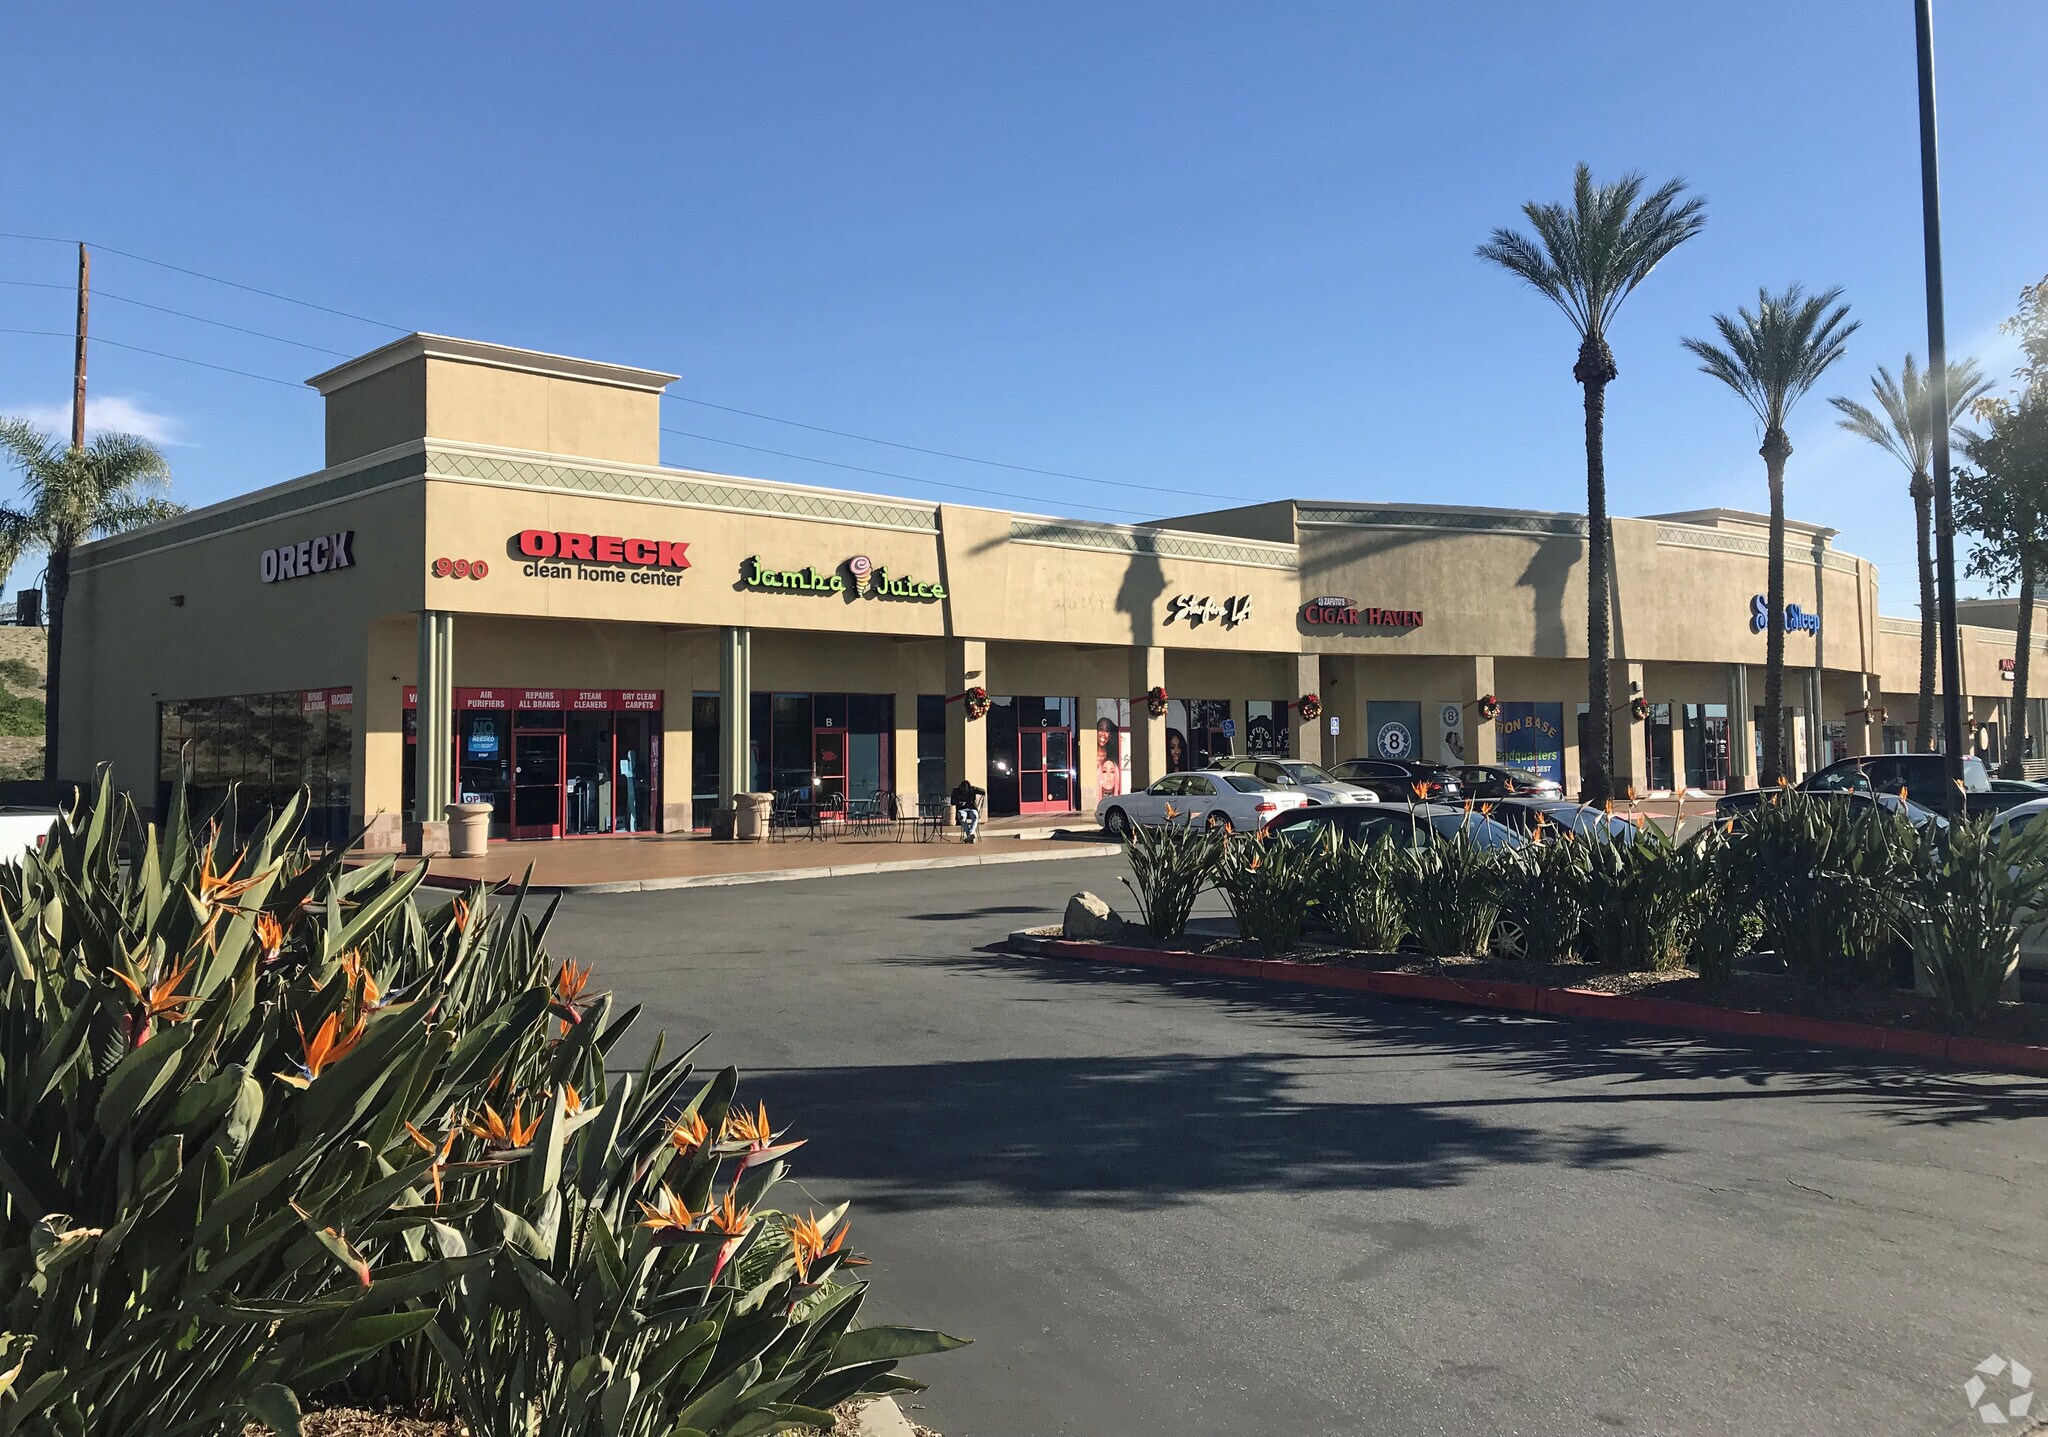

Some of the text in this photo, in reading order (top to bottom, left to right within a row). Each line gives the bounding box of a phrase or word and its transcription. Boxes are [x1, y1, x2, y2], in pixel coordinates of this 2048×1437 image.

[519, 529, 692, 568] ORECK
[260, 531, 353, 583] ORECK
[435, 557, 489, 580] 990
[747, 554, 846, 592] jamba
[523, 562, 683, 587] clean home center
[1231, 594, 1254, 626] LA
[1305, 605, 1424, 627] CIGAR HAVEN
[1791, 603, 1820, 635] Sleep
[479, 691, 493, 699] AIR
[525, 691, 554, 700] REPAIRS
[579, 692, 602, 700] STEAM
[622, 692, 657, 701] DRY CLEAN
[467, 699, 505, 708] PURIFIERS
[518, 700, 560, 709] ALL BRANDS
[573, 700, 608, 709] CLEANERS
[625, 701, 654, 709] CARPETS
[1447, 711, 1454, 721] 8
[825, 718, 833, 727] B
[1041, 718, 1048, 727] C
[1525, 716, 1557, 739] BASE
[1389, 733, 1400, 750] 8
[1496, 750, 1558, 764] eadquarters
[465, 795, 494, 804] OPEN
